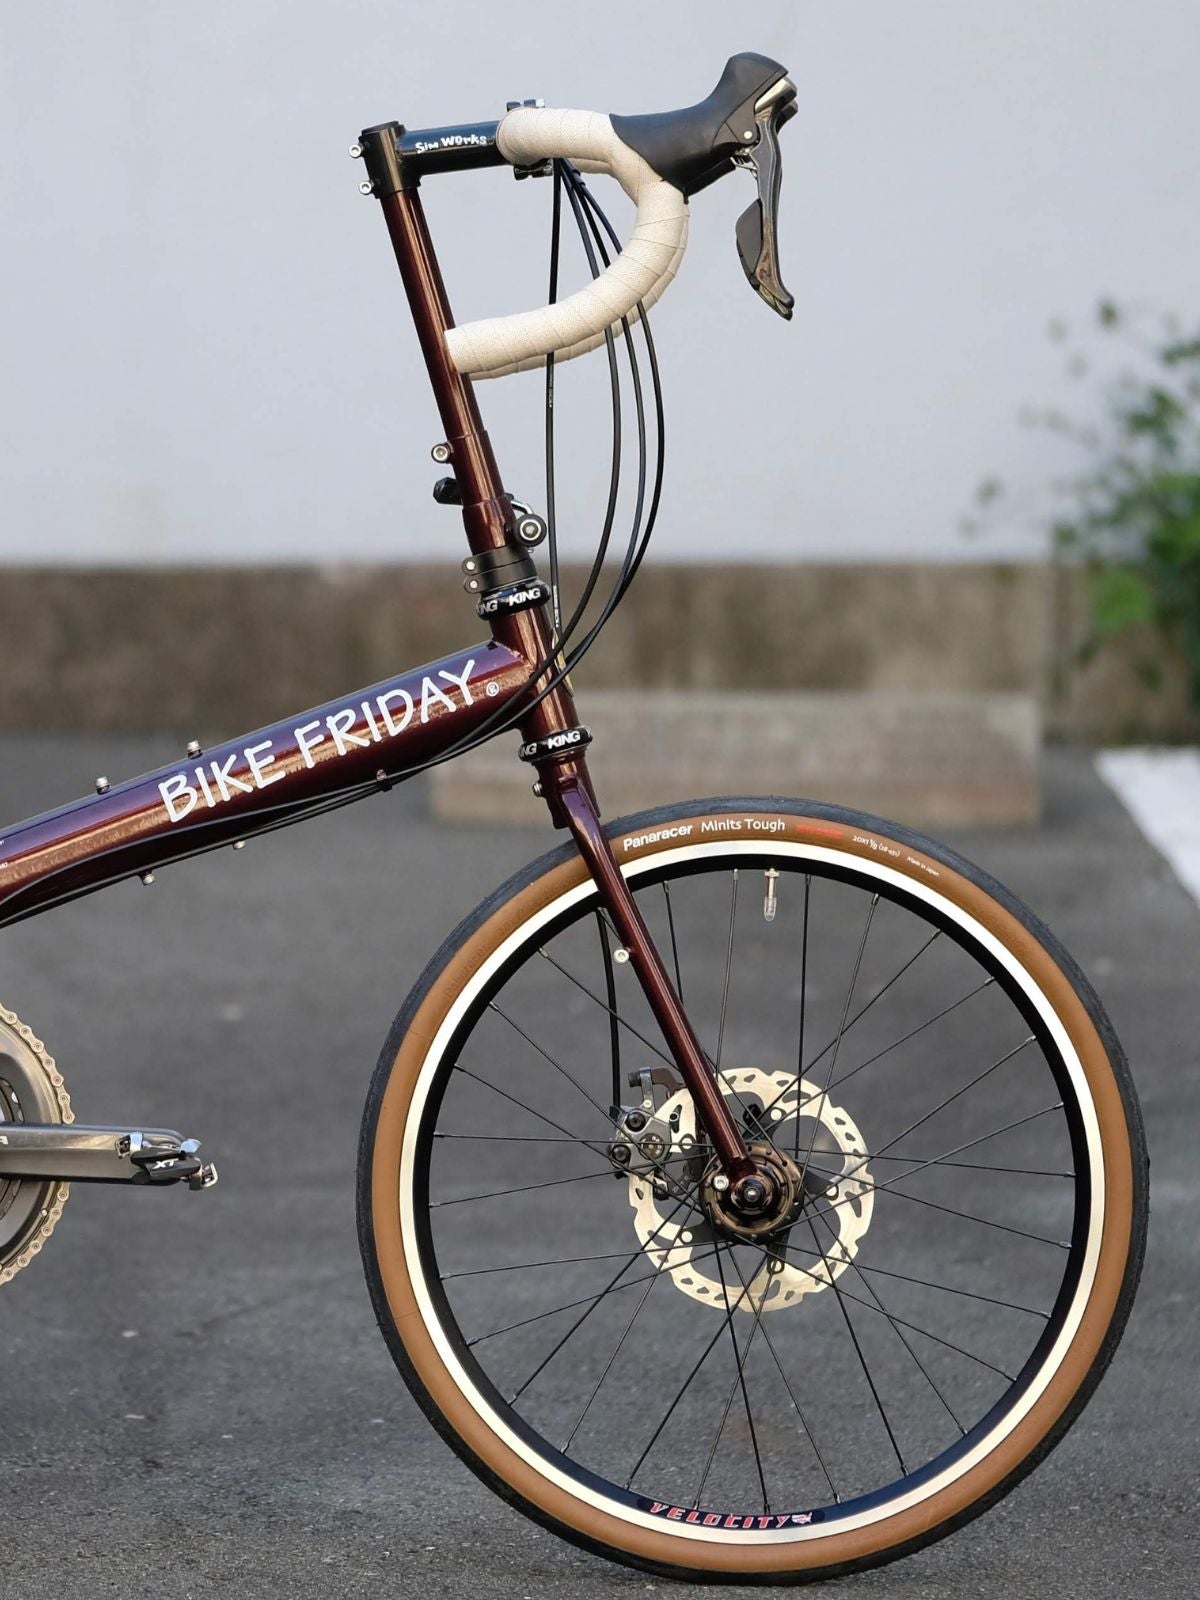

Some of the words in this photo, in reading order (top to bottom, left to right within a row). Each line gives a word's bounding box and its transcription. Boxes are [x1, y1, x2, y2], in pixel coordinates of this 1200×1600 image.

[509, 587, 541, 607] KING
[158, 740, 286, 822] BIKE
[294, 659, 475, 769] FRIDAY
[547, 730, 580, 750] KING
[623, 824, 693, 851] Panaracer
[701, 819, 742, 832] Minits
[744, 818, 786, 833] Tough
[152, 1158, 179, 1170] XT
[650, 1502, 791, 1528] VELOCITY
